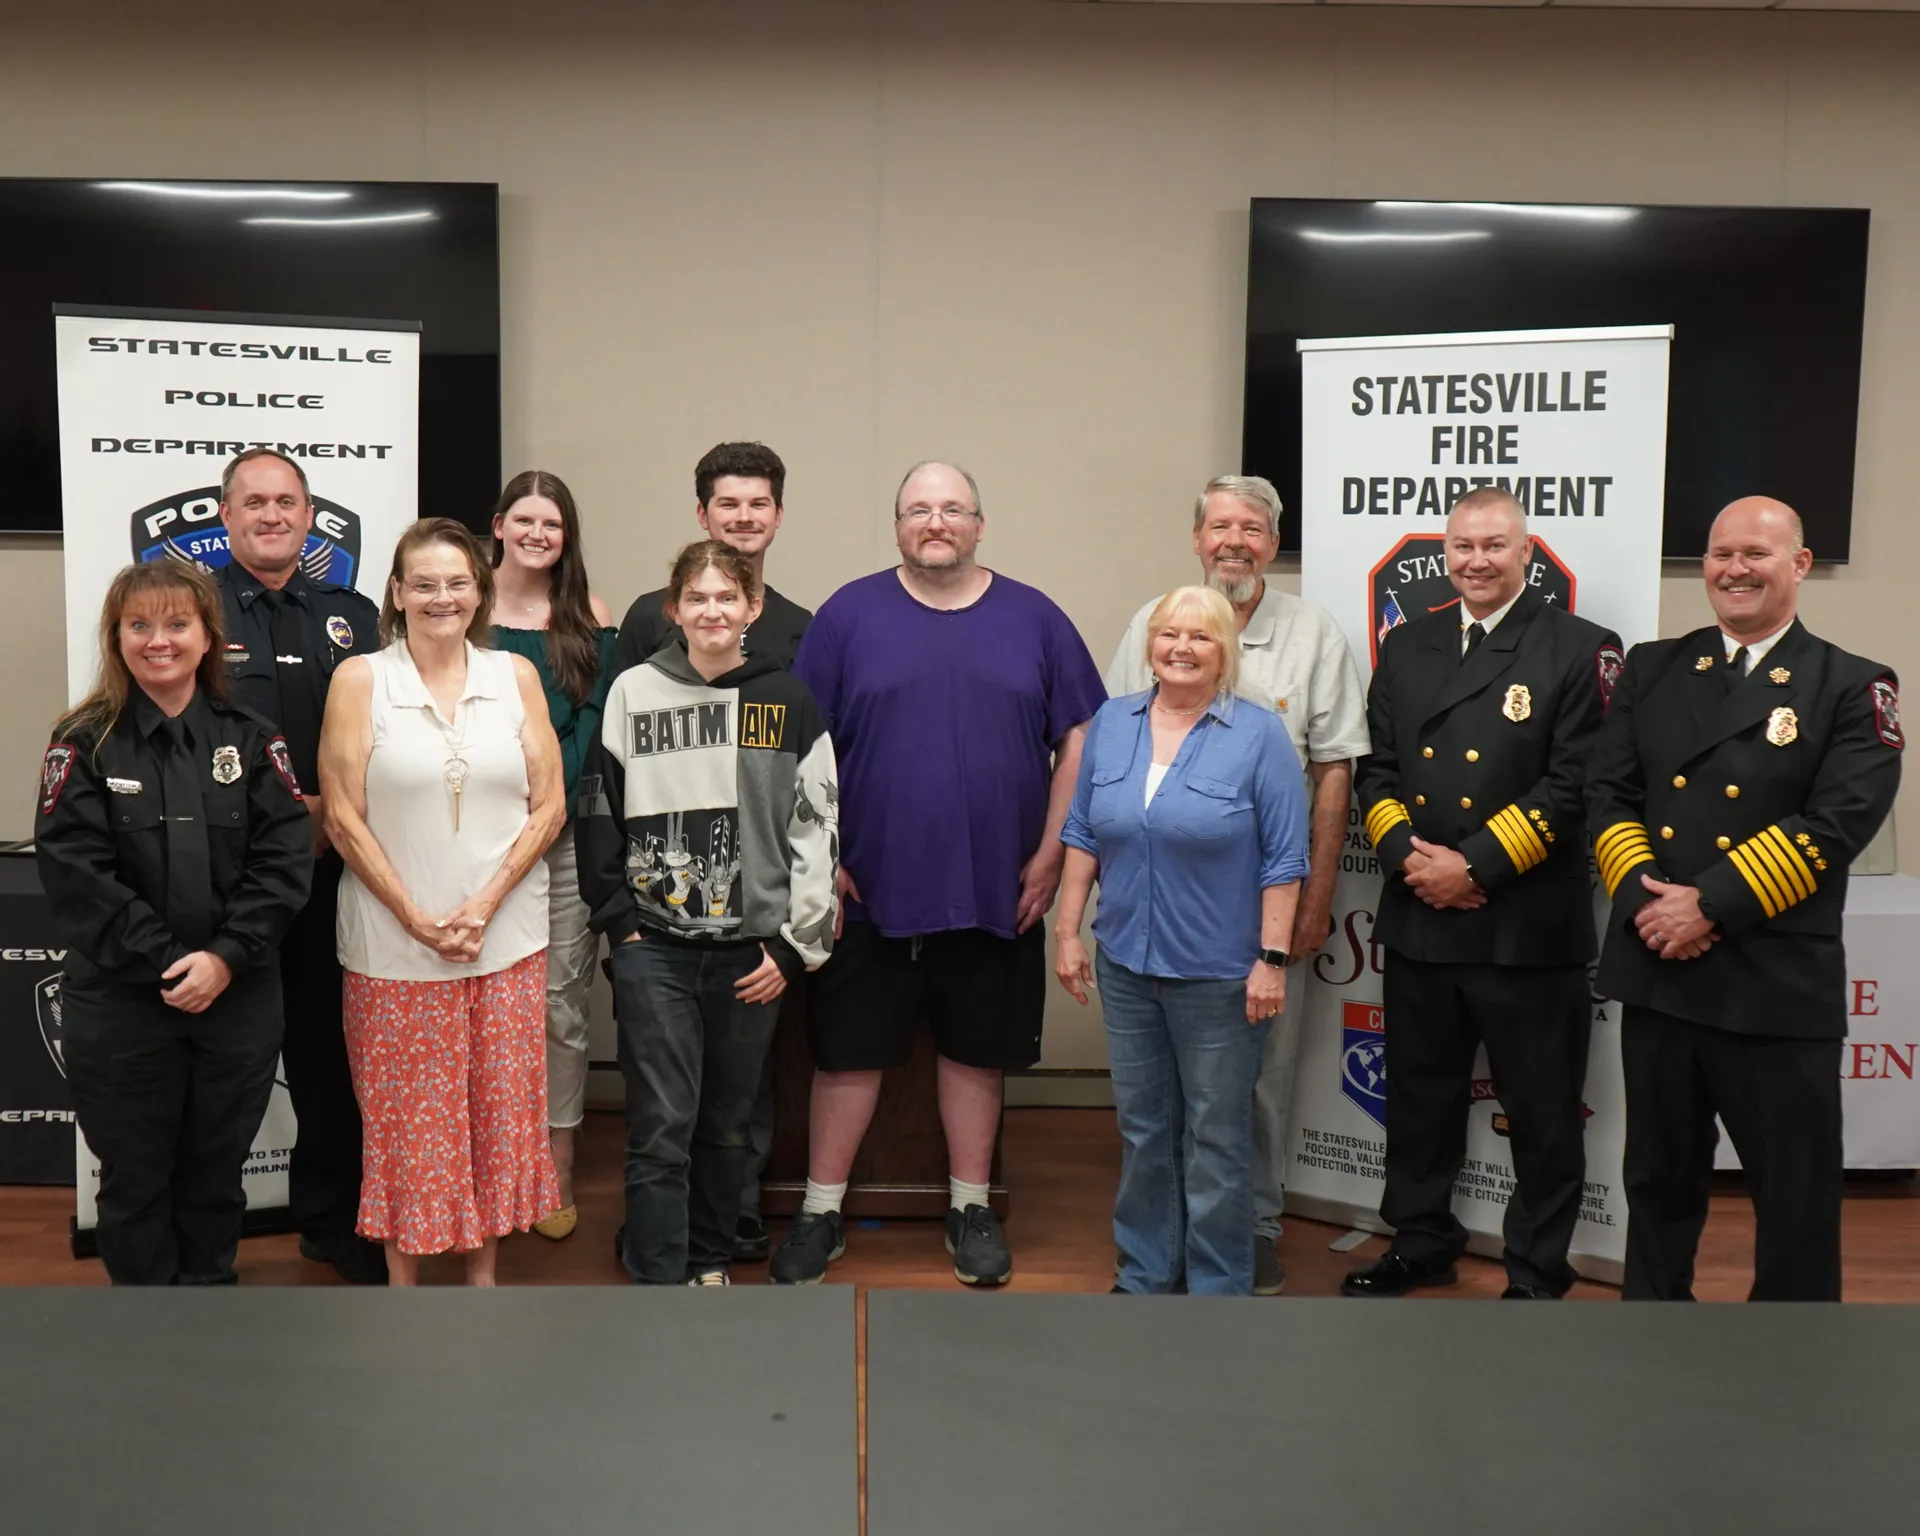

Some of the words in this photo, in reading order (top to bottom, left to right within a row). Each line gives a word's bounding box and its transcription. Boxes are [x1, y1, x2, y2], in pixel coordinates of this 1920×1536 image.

[88, 337, 393, 364] STATESVILLE
[165, 390, 324, 409] POLICE
[1351, 370, 1607, 416] STATESVILLE
[1431, 425, 1519, 465] FIRE
[628, 701, 786, 757] BATMAN
[0, 948, 68, 961] ESV
[1302, 1128, 1320, 1142] THE
[1322, 1132, 1385, 1154] STATESVILLE
[1485, 1162, 1511, 1178] WILL
[1296, 1154, 1357, 1175] PROTECTION
[1453, 1184, 1472, 1198] THE
